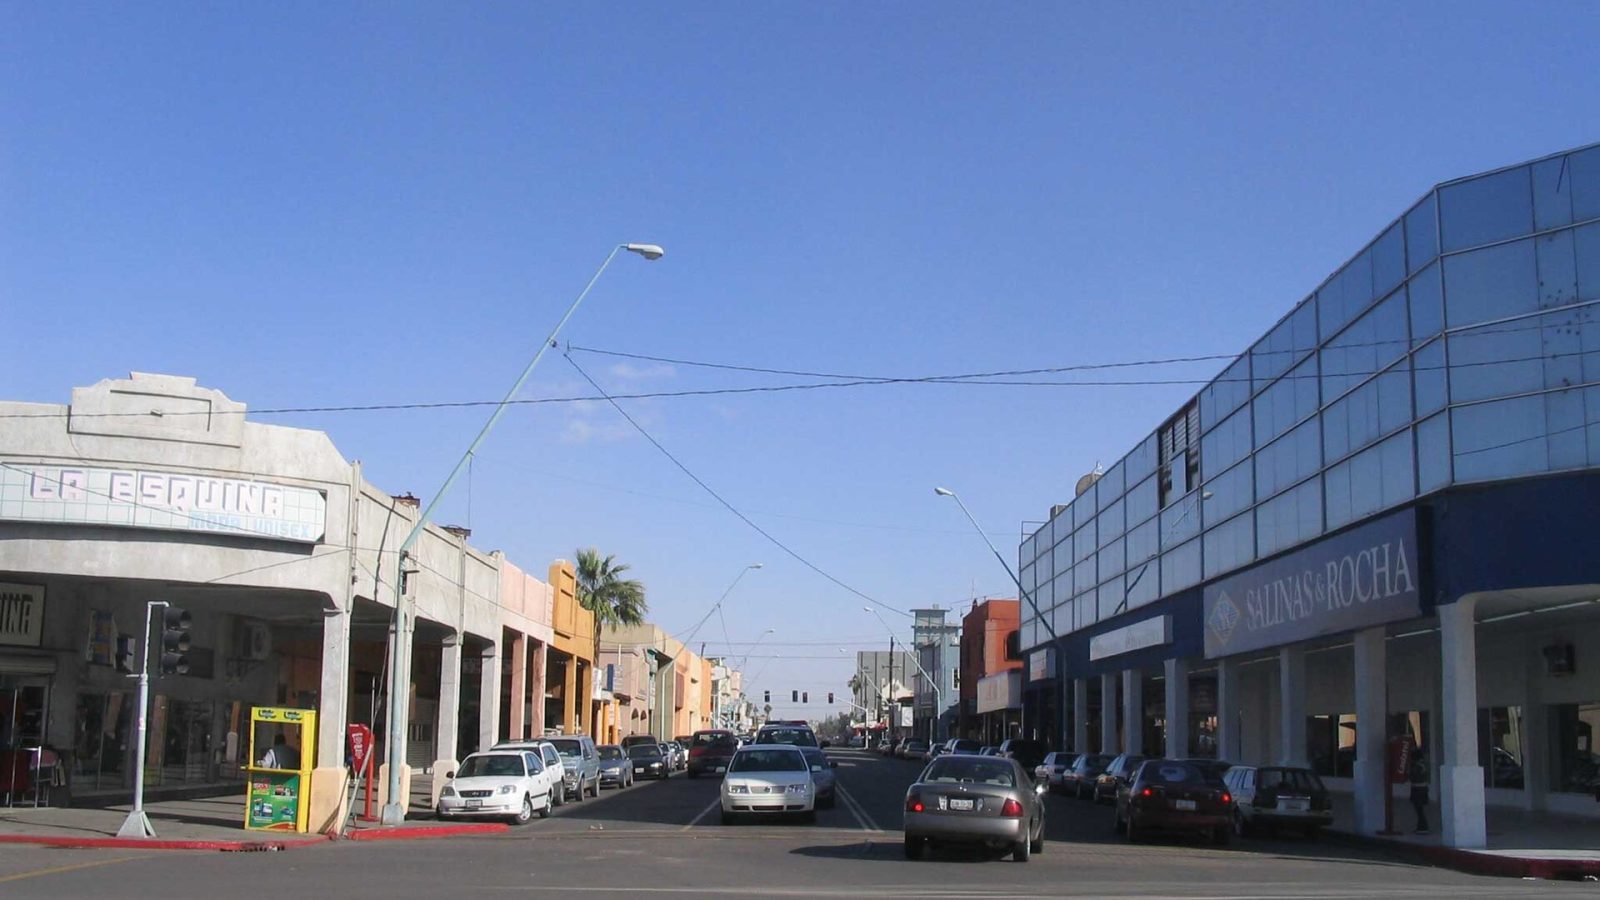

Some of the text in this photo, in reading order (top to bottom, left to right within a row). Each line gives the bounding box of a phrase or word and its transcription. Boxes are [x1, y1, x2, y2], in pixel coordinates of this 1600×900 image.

[30, 470, 282, 515] LA ESQUINA
[1246, 538, 1414, 630] SALINAS & ROCHA
